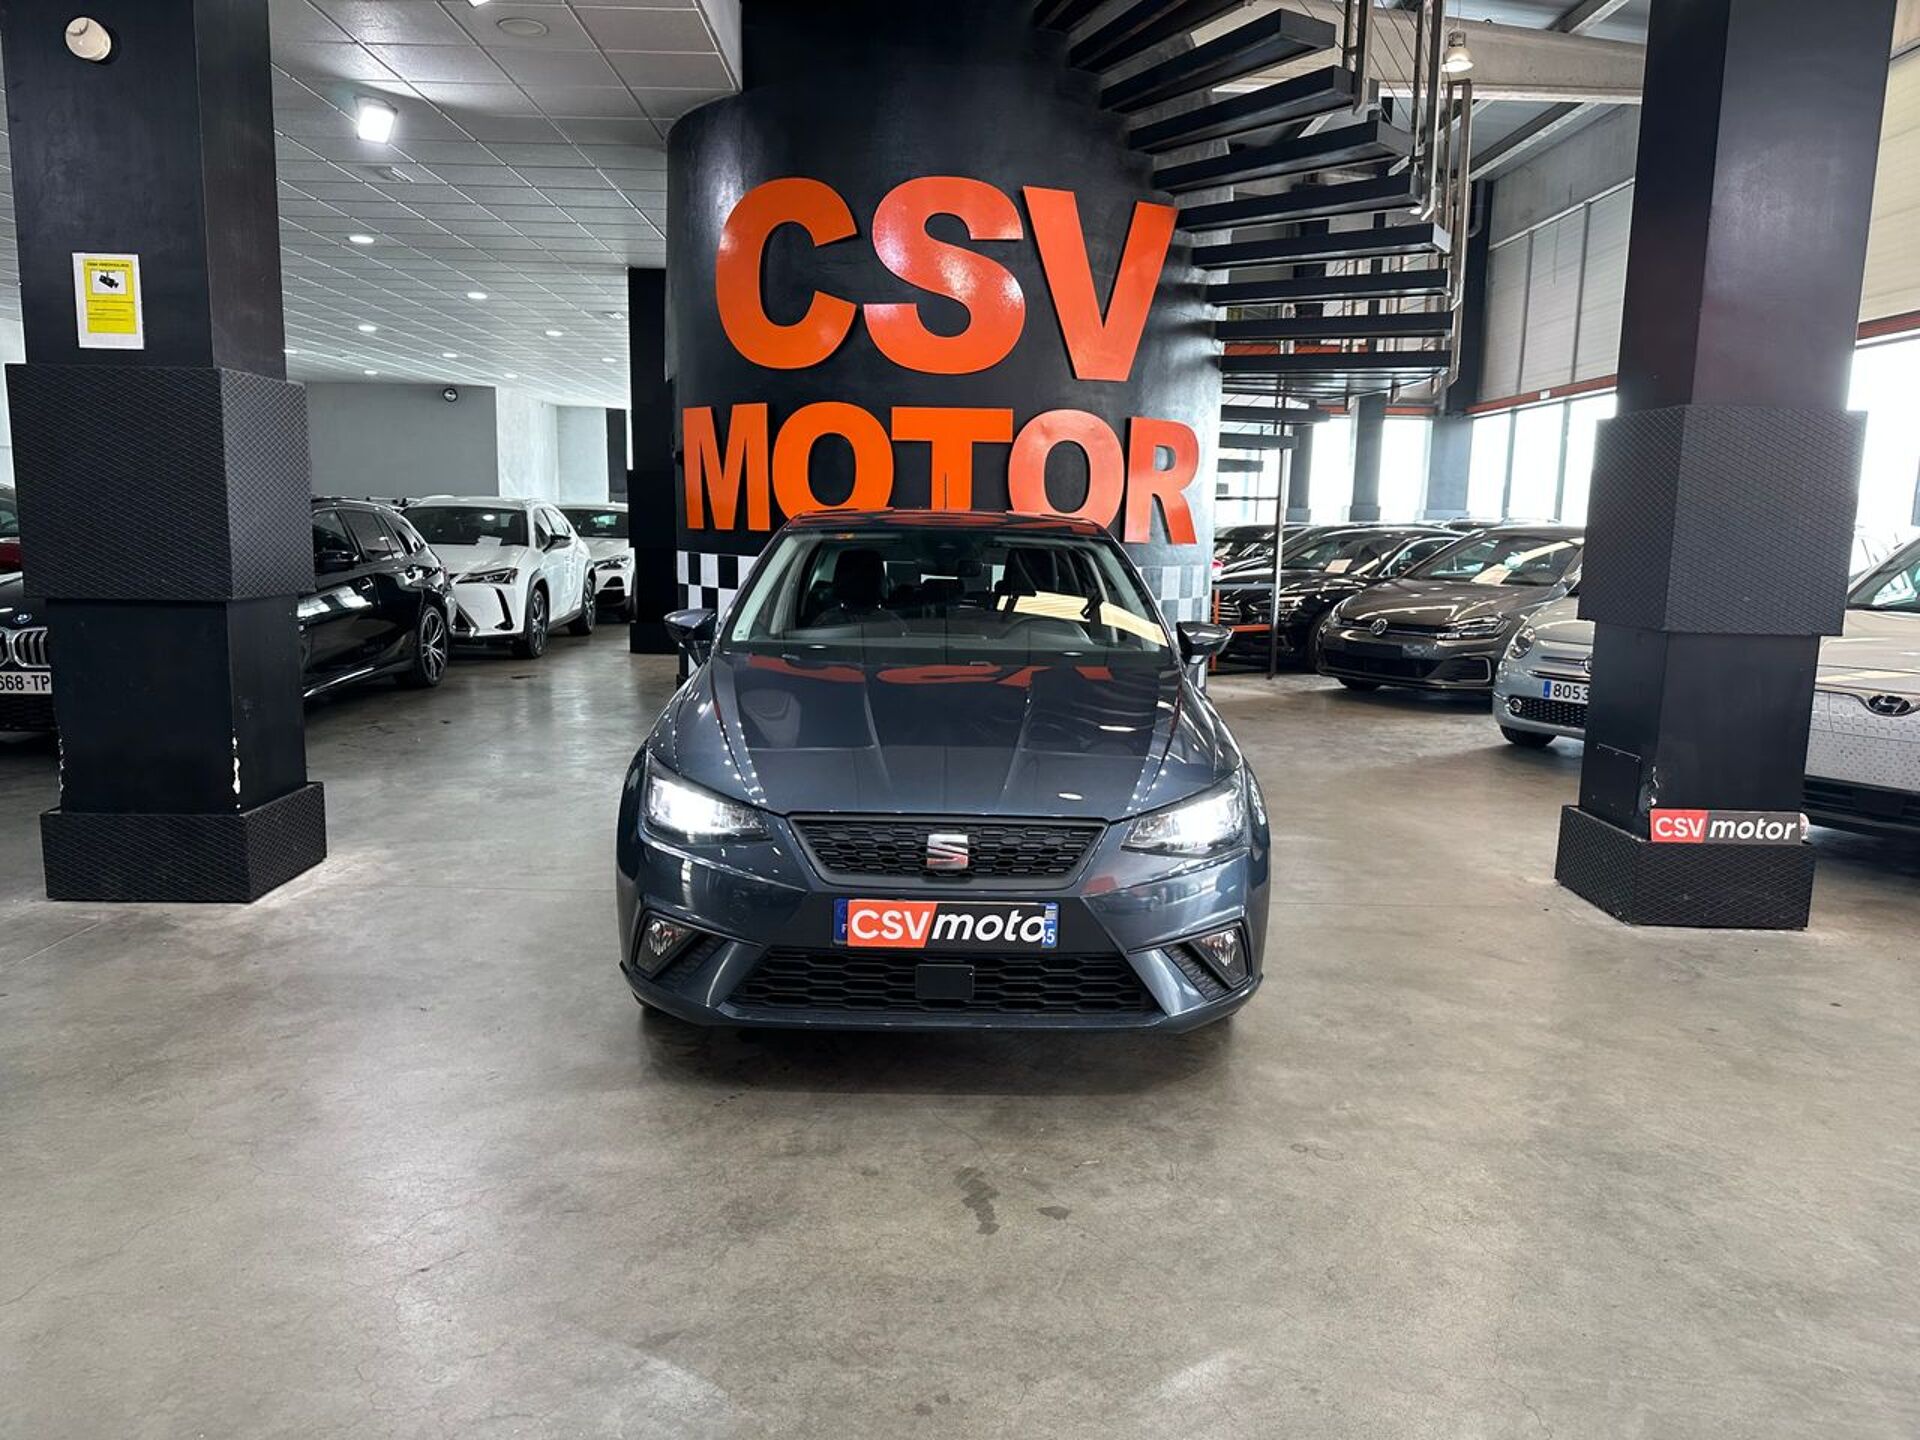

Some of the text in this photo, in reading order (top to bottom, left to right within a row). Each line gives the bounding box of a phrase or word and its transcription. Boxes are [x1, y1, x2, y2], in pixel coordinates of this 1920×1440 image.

[715, 175, 1179, 382] CSV
[682, 401, 1199, 544] MOTOR
[1655, 816, 1797, 840] CSV motor
[850, 908, 931, 941] CSV
